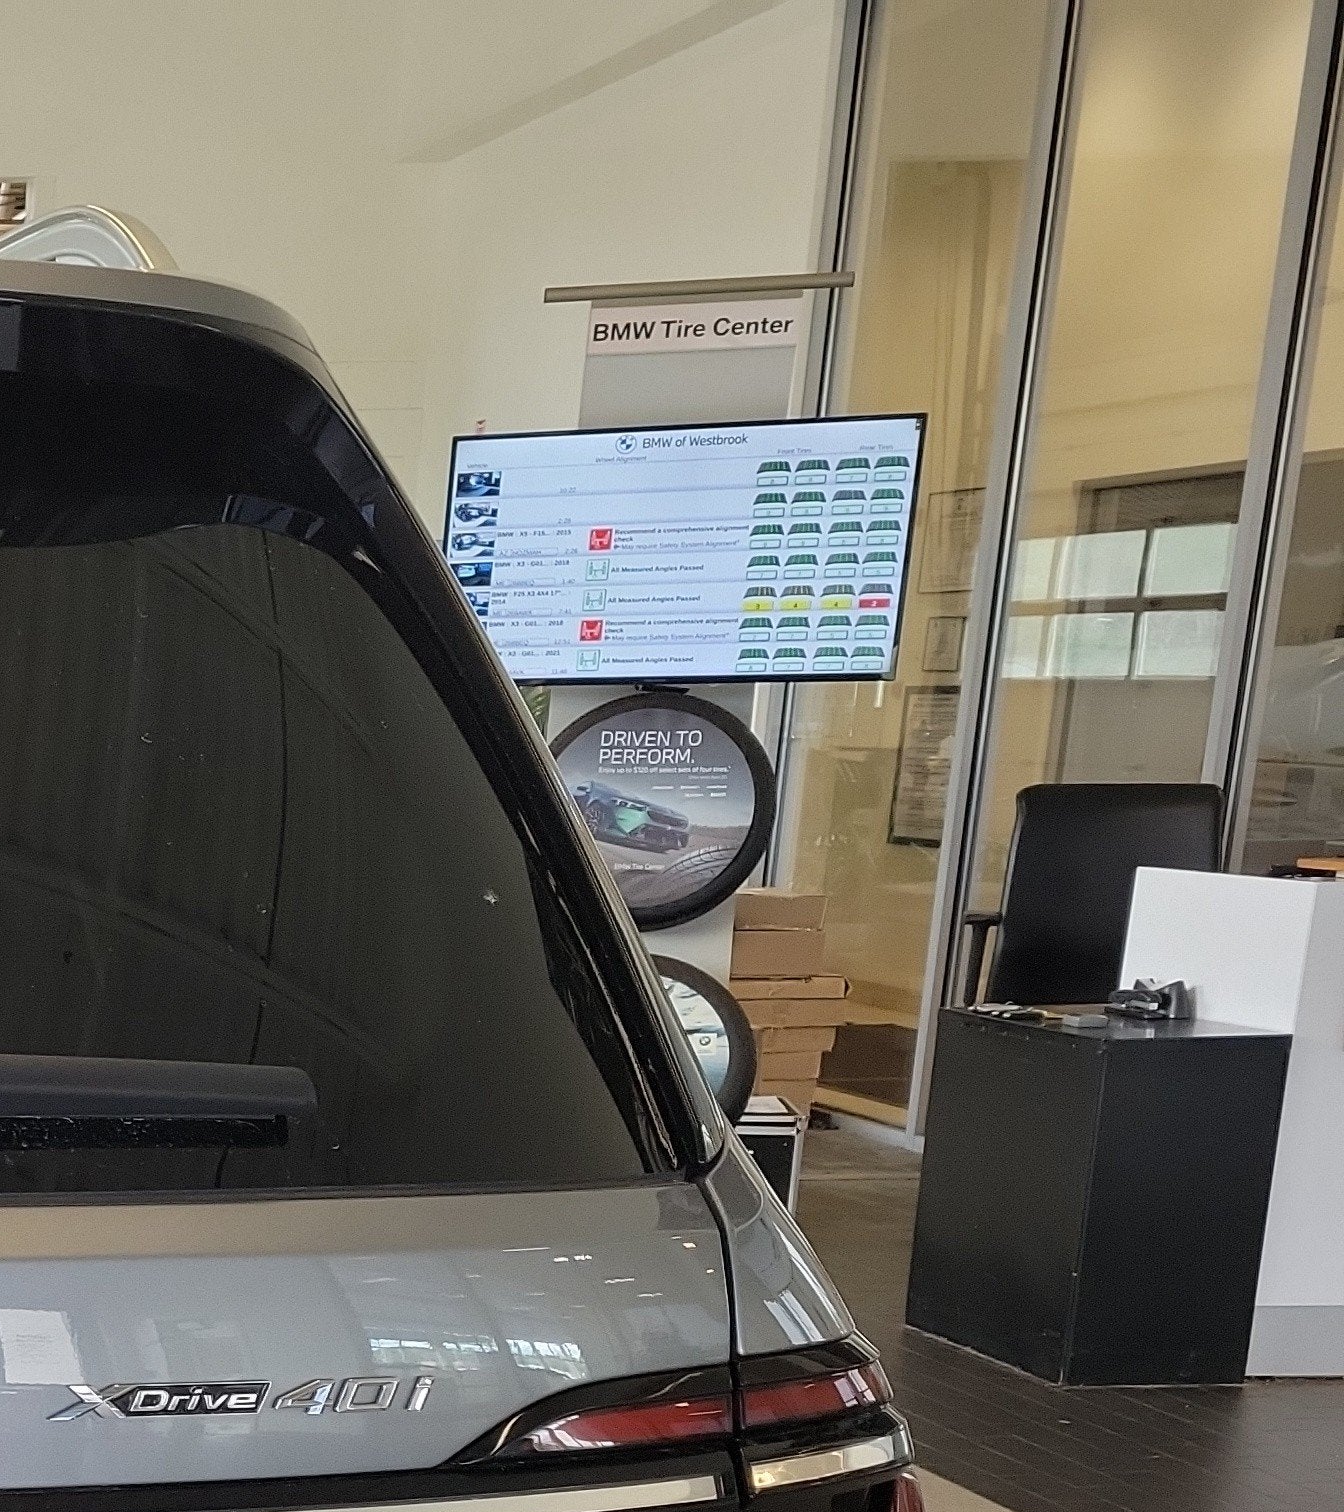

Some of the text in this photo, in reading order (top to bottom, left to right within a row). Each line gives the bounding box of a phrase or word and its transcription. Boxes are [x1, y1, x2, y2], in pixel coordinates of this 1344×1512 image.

[593, 317, 793, 341] BMW Tire Center
[642, 433, 748, 449] BMW of Westbrook
[705, 617, 739, 625] alignment
[601, 730, 703, 747] DRIVEN TO
[598, 748, 695, 765] PERFORM.
[598, 766, 616, 775] Enjoy
[274, 1375, 435, 1416] 40i
